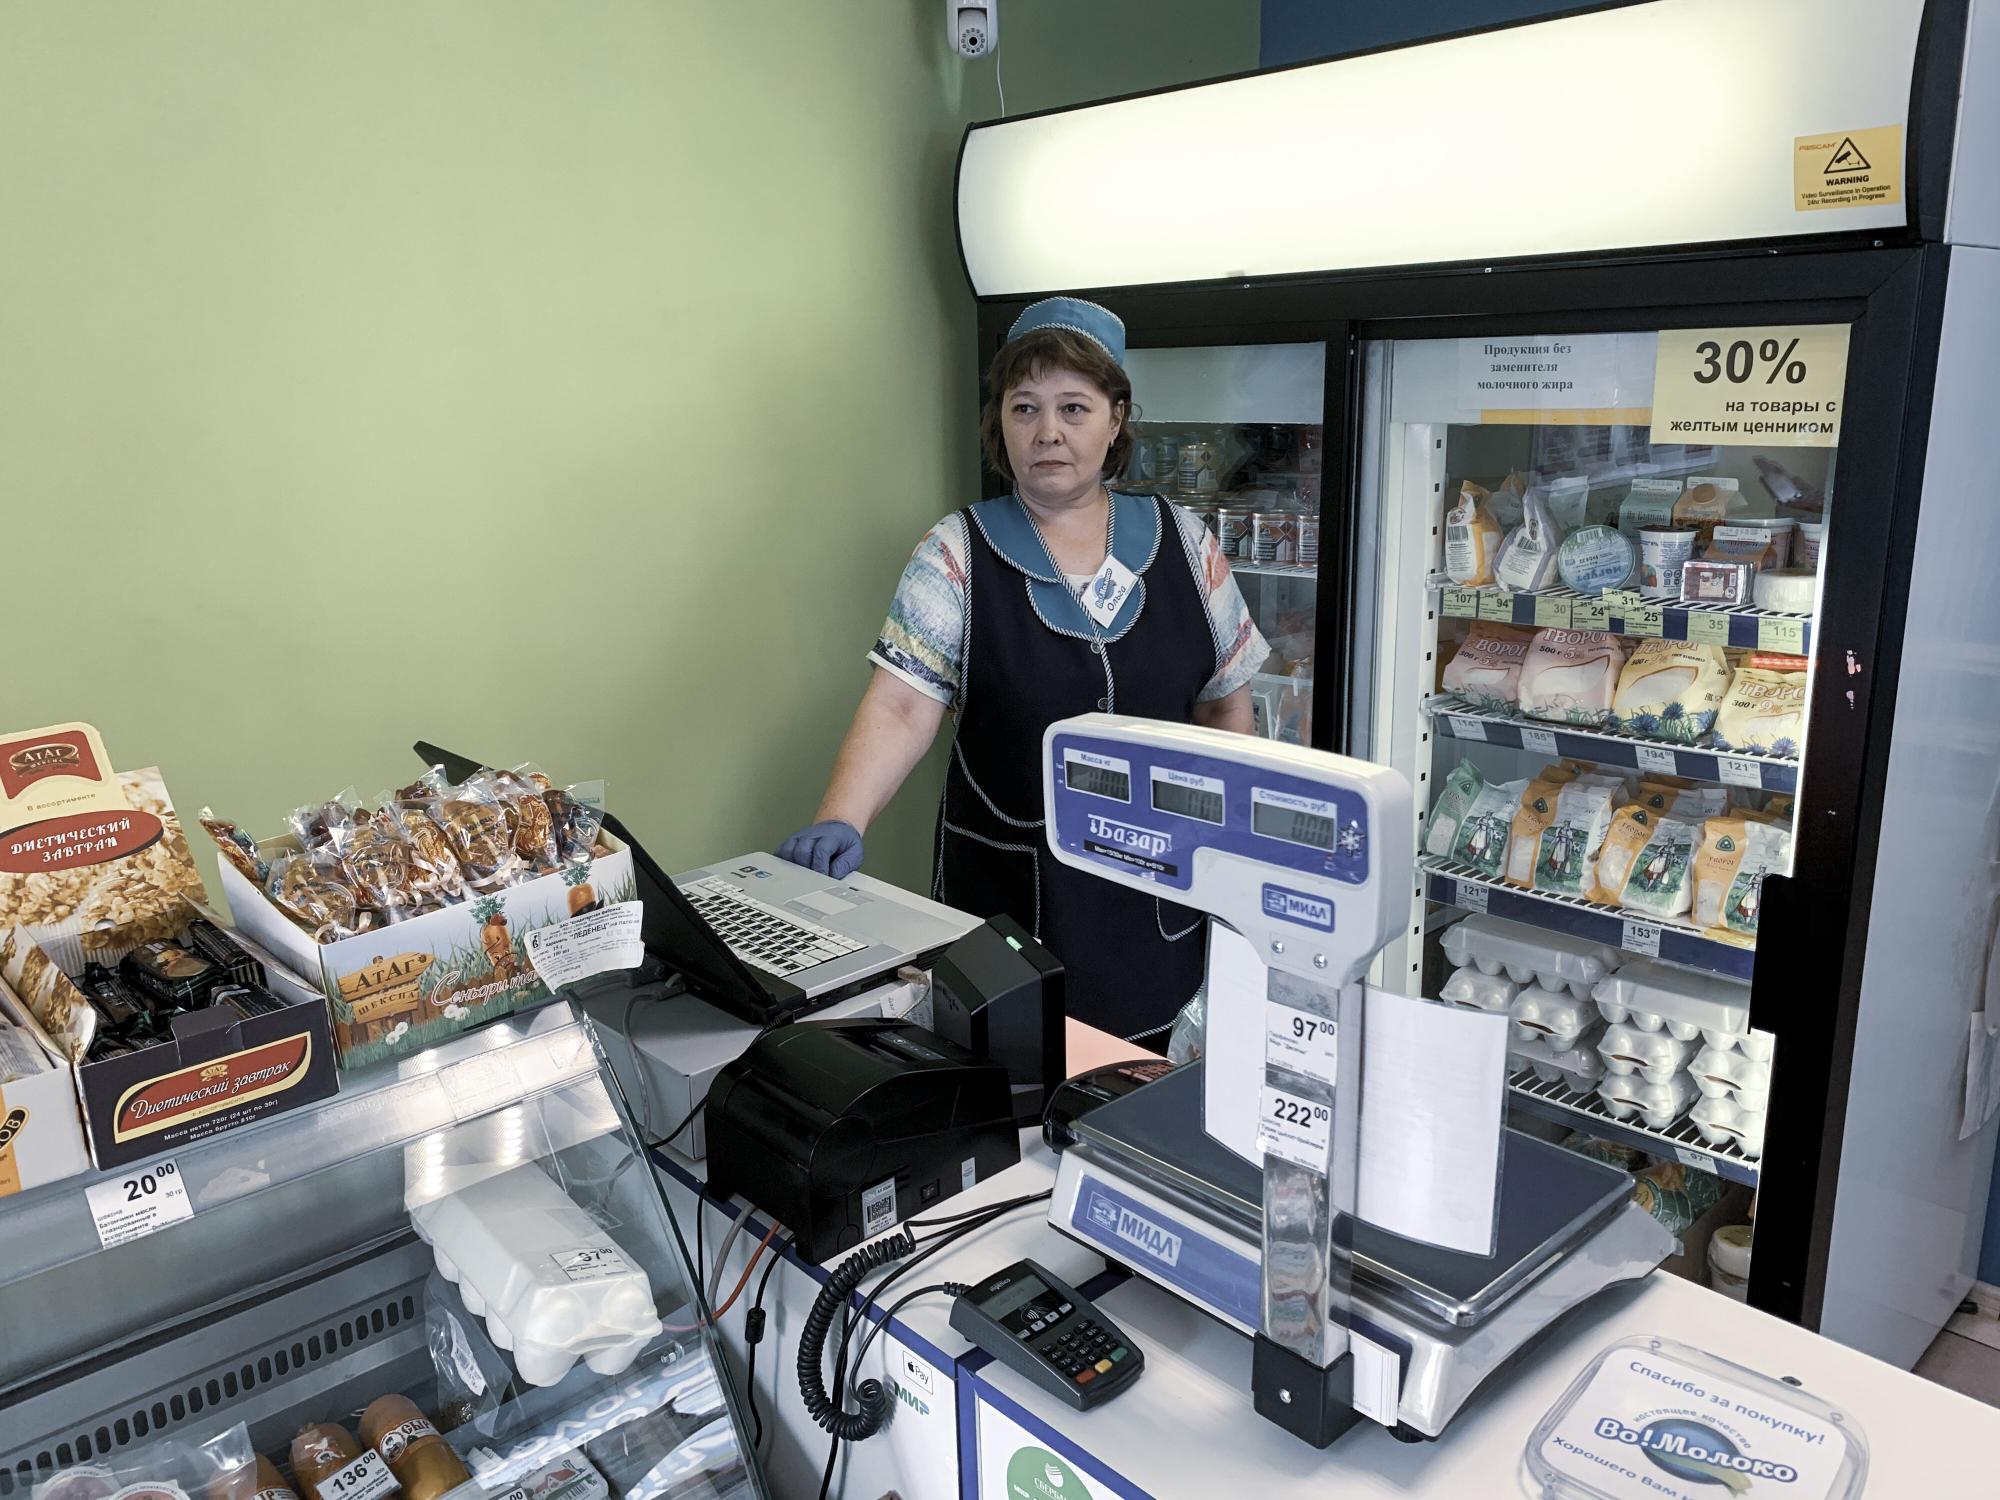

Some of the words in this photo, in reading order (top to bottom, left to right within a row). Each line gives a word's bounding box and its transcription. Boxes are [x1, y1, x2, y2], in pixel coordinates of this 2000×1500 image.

[1826, 175, 1869, 186] WARNING
[1818, 188, 1853, 197] Surveillance
[1862, 185, 1891, 193] Operation
[1858, 193, 1885, 201] Progress
[1484, 343, 1549, 357] Продукция
[1553, 343, 1571, 354] без
[1490, 361, 1558, 373] заменителя
[1694, 338, 1807, 386] 30%
[1477, 380, 1538, 391] молочного
[1541, 379, 1573, 391] жира
[1725, 401, 1745, 412] на
[1750, 401, 1820, 414] товары
[1825, 402, 1836, 412] с
[1670, 419, 1738, 432] желтым
[1743, 419, 1834, 435] ценником
[1107, 586, 1126, 612] Ольга
[1455, 594, 1472, 604] 107
[1497, 598, 1509, 608] 94
[1622, 596, 1634, 605] 31
[1554, 603, 1567, 614] 30
[1591, 607, 1604, 616] 24
[1644, 612, 1658, 622] 25
[1709, 619, 1724, 630] 35
[1774, 626, 1796, 638] 115
[1459, 650, 1474, 659] 300
[1539, 645, 1556, 654] 500
[1732, 699, 1749, 708] 300
[1081, 753, 1102, 765] Масса
[1644, 749, 1665, 760] 194
[1727, 761, 1749, 772] 121
[1168, 772, 1188, 783] Цена
[1189, 777, 1205, 787] руб
[36, 793, 96, 809] ассортименте
[1259, 790, 1307, 809] Стоимость
[1310, 802, 1328, 813] руб
[11, 817, 131, 855] ДИЕТИЧЕСКИЙ
[1096, 818, 1167, 857] Базар
[42, 836, 118, 862] ЗАВТРАК
[1463, 885, 1479, 896] 121
[1289, 899, 1327, 920] МИДЛ
[1630, 926, 1650, 938] 153
[431, 969, 539, 1007] Сеньорита
[358, 991, 415, 1016] ШЕКСНА
[1293, 1017, 1317, 1041] 97
[1320, 1021, 1335, 1036] 00
[131, 1078, 230, 1120] Диетический
[231, 1061, 292, 1093] завтрак
[1274, 1098, 1311, 1128] 222
[1314, 1107, 1328, 1121] 00
[164, 1129, 188, 1141] Масса
[189, 1122, 210, 1132] нетто
[212, 1116, 228, 1126] 720г
[229, 1111, 241, 1120] (24
[242, 1108, 252, 1117] шт
[254, 1104, 263, 1113] по
[190, 1128, 213, 1140] Масса
[215, 1120, 240, 1132] брутто
[123, 1174, 157, 1202] 20
[156, 1163, 175, 1178] 00
[104, 1223, 149, 1241] ассортименте
[1120, 1212, 1174, 1260] МИДЛ
[915, 1366, 930, 1388] Pay
[894, 1386, 931, 1416] МИР
[1630, 1361, 1705, 1399] Спасибо
[1710, 1394, 1730, 1408] за
[1736, 1404, 1826, 1446] покупку!
[1633, 1407, 1697, 1424] настоящее
[1701, 1412, 1752, 1450] качество
[333, 1463, 368, 1492] 136
[362, 1452, 377, 1464] 00
[1552, 1436, 1637, 1480] Хорошего
[1641, 1476, 1678, 1498] Вам
